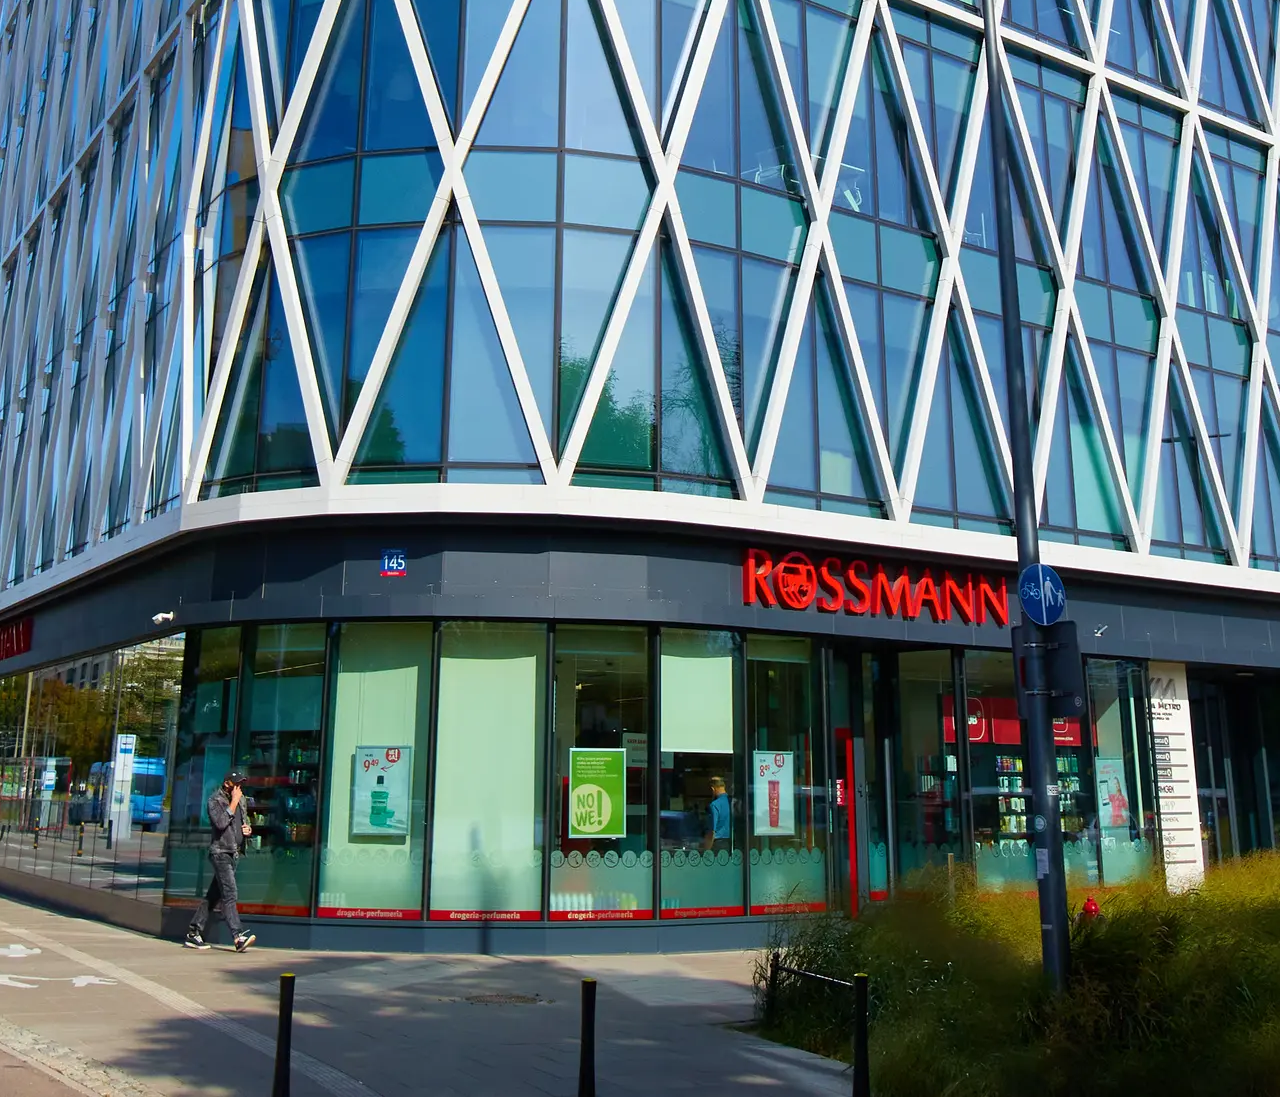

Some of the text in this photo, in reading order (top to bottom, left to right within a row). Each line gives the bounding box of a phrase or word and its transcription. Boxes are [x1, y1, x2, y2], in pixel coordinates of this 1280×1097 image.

[383, 555, 405, 570] 145
[742, 548, 1009, 628] ROSSMANN
[576, 793, 595, 809] NO
[337, 909, 403, 918] drogeria-perfumeria
[449, 911, 521, 920] drogeria-perfumeria
[567, 911, 634, 920] drogeria-perfumeria
